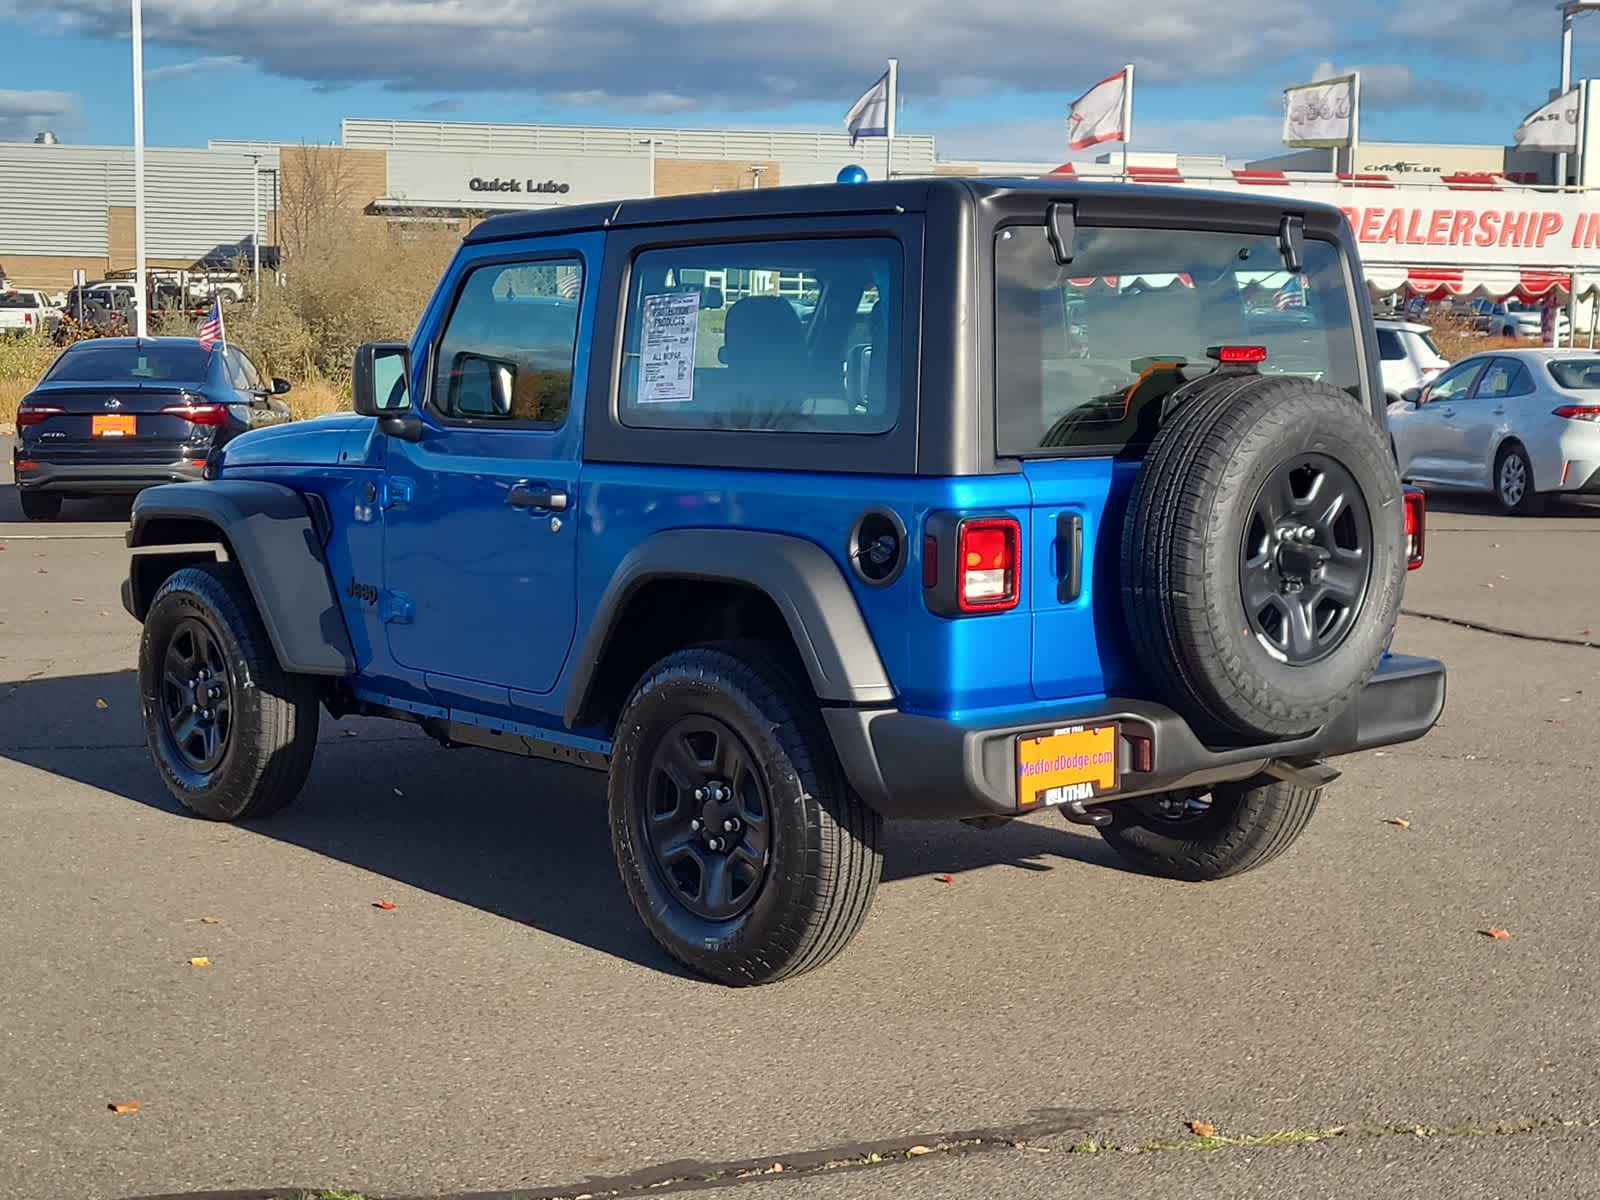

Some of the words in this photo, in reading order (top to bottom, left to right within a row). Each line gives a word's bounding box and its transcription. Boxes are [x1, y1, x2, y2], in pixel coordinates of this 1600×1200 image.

[1364, 164, 1442, 174] CHRSLER
[469, 178, 521, 192] Quick
[527, 179, 570, 193] Lube
[1340, 207, 1563, 248] DEALERSHIP
[346, 576, 378, 606] Jeep
[1020, 751, 1113, 777] MedfordDodge.com
